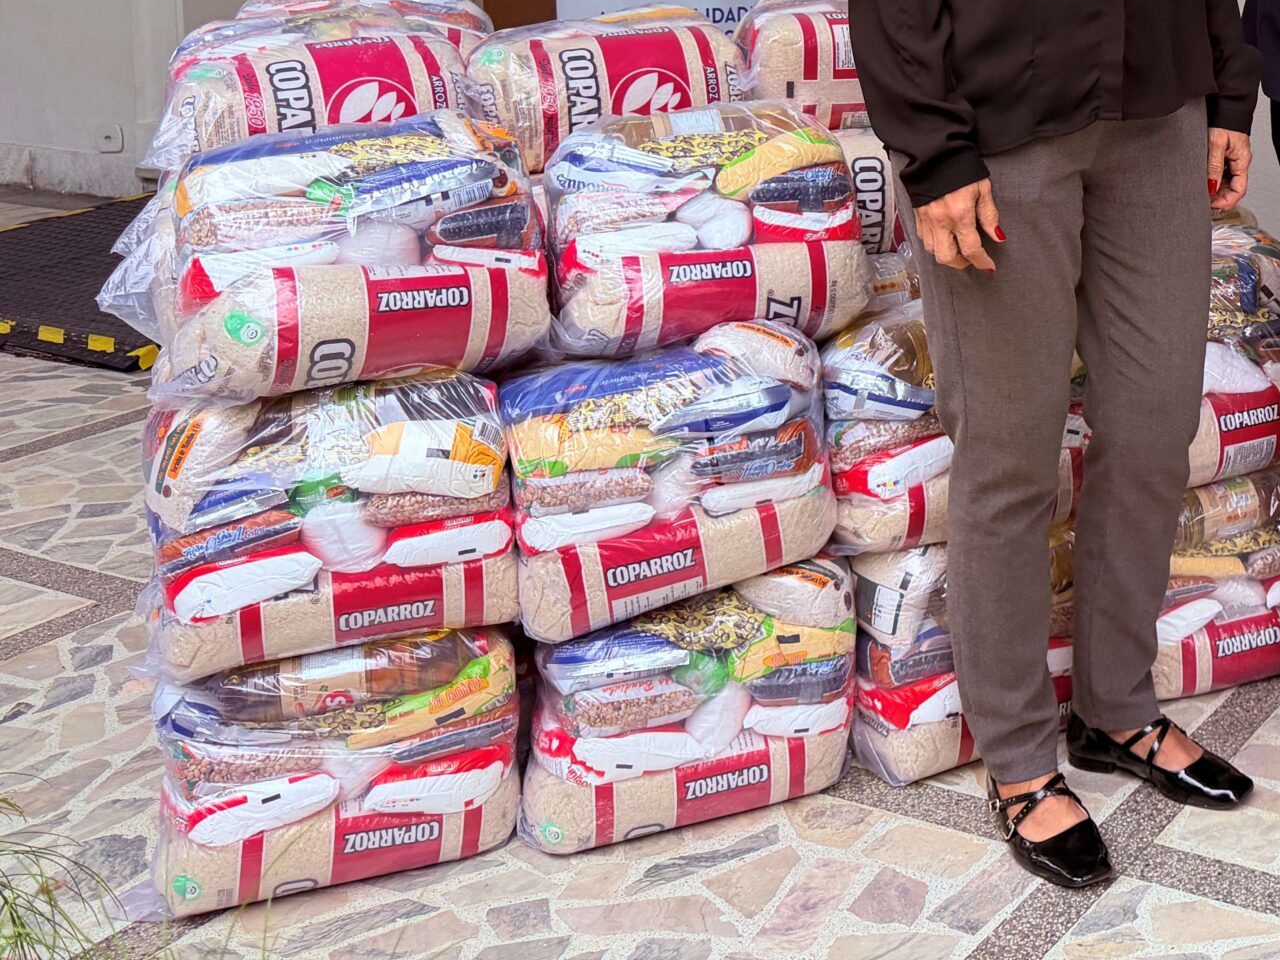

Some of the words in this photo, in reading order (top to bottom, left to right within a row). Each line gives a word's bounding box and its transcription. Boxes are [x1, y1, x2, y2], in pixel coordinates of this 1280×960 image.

[265, 59, 317, 135] COPA
[431, 74, 447, 109] ARROZ
[540, 80, 558, 114] 1950
[705, 65, 720, 99] ARROZ
[244, 92, 265, 129] 1950
[668, 259, 753, 284] COPARROZ
[376, 285, 471, 313] COPARROZ
[1219, 403, 1280, 432] COPARROZ
[606, 548, 697, 589] COPARROZ
[338, 599, 436, 631] COPARROZ
[684, 763, 770, 801] COPARROZ
[342, 820, 440, 854] COPARROZ
